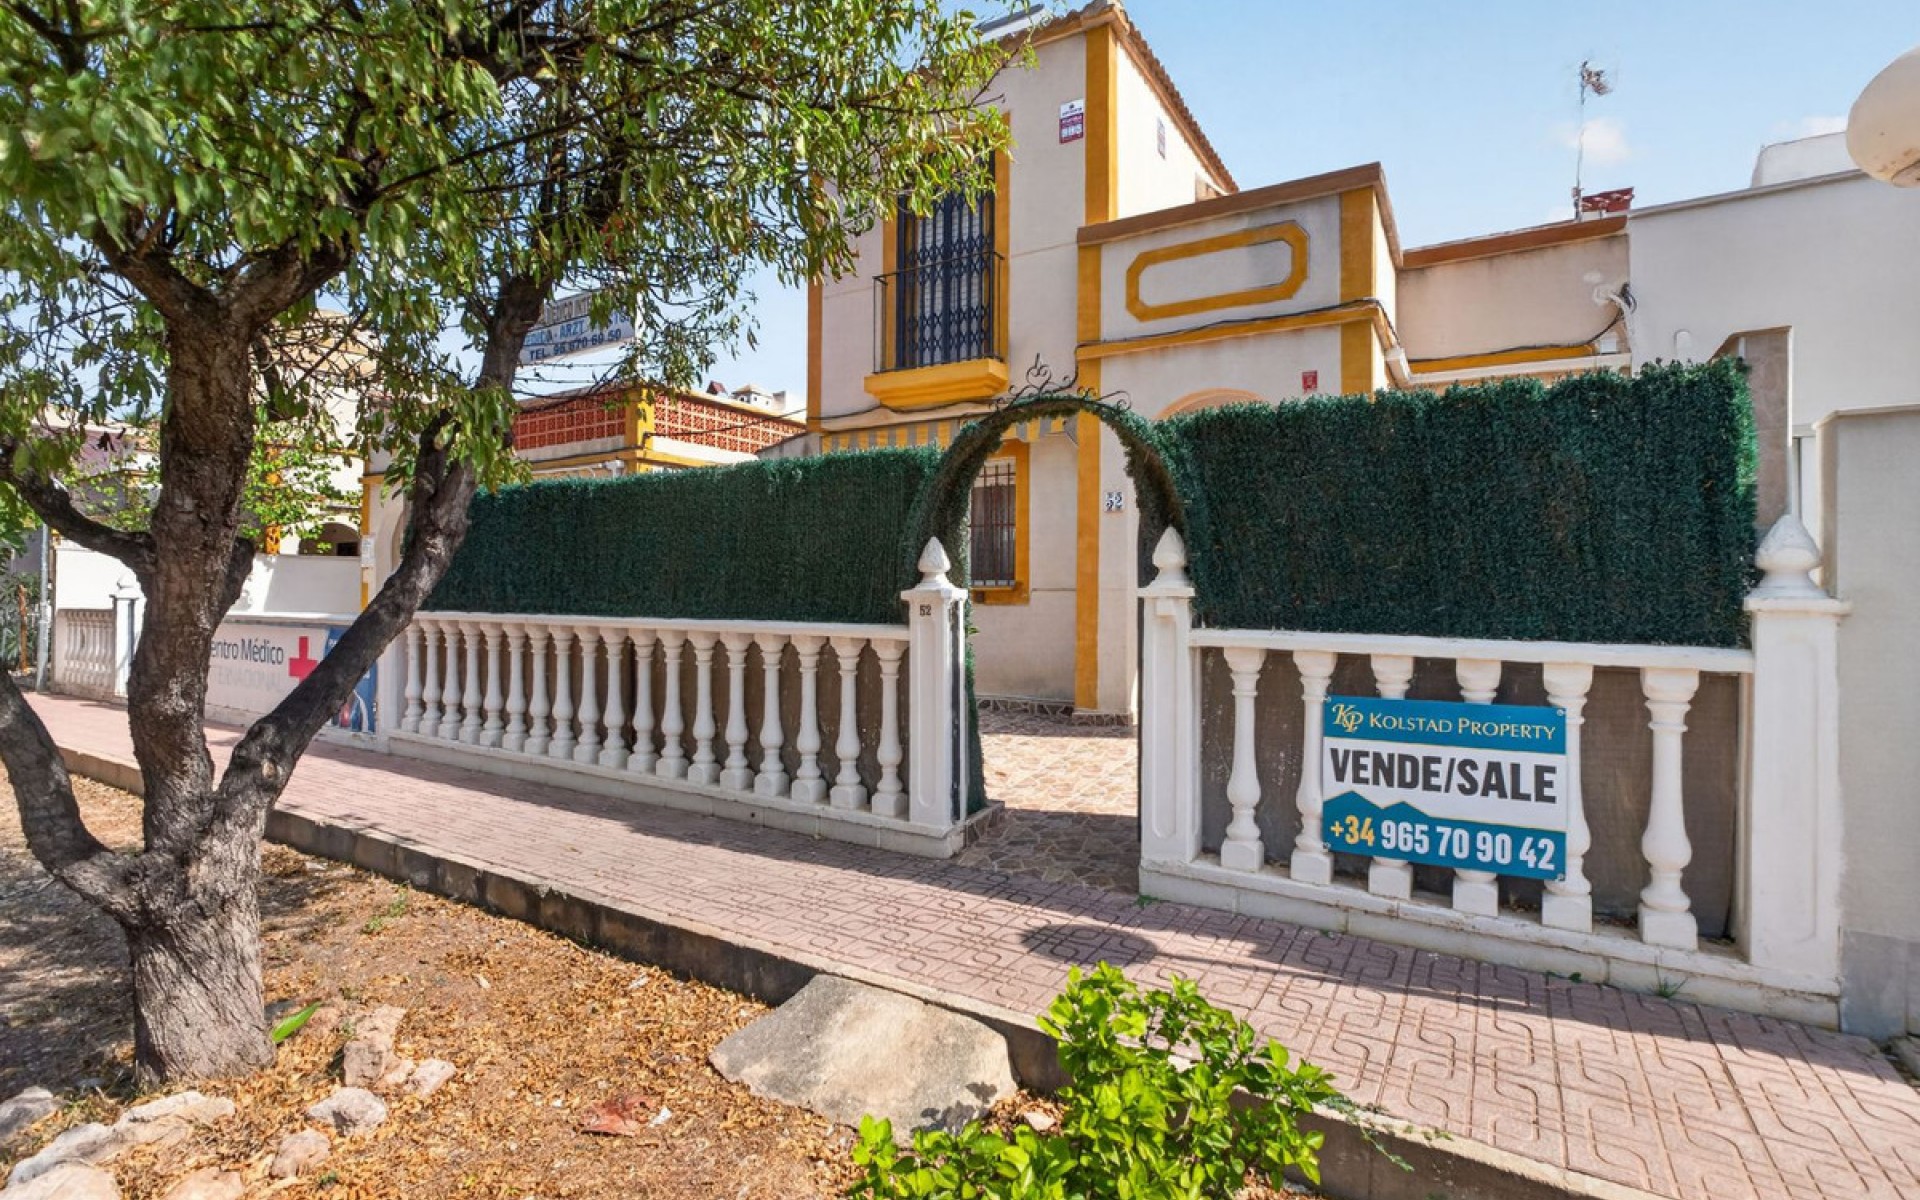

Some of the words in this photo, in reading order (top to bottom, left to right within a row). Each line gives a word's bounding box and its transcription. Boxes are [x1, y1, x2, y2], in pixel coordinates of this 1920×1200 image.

[1105, 491, 1122, 511] 52
[920, 604, 932, 617] 52
[211, 639, 239, 660] entro
[241, 637, 284, 665] Médico
[1369, 712, 1453, 733] KOLSTAD
[1458, 718, 1556, 741] PROPERTY
[1330, 748, 1558, 804] VENDE/SALE
[1330, 815, 1375, 847] +34
[1380, 819, 1431, 855] 965
[1436, 826, 1470, 861] 70
[1476, 831, 1513, 866] 90
[1519, 837, 1556, 871] 42
